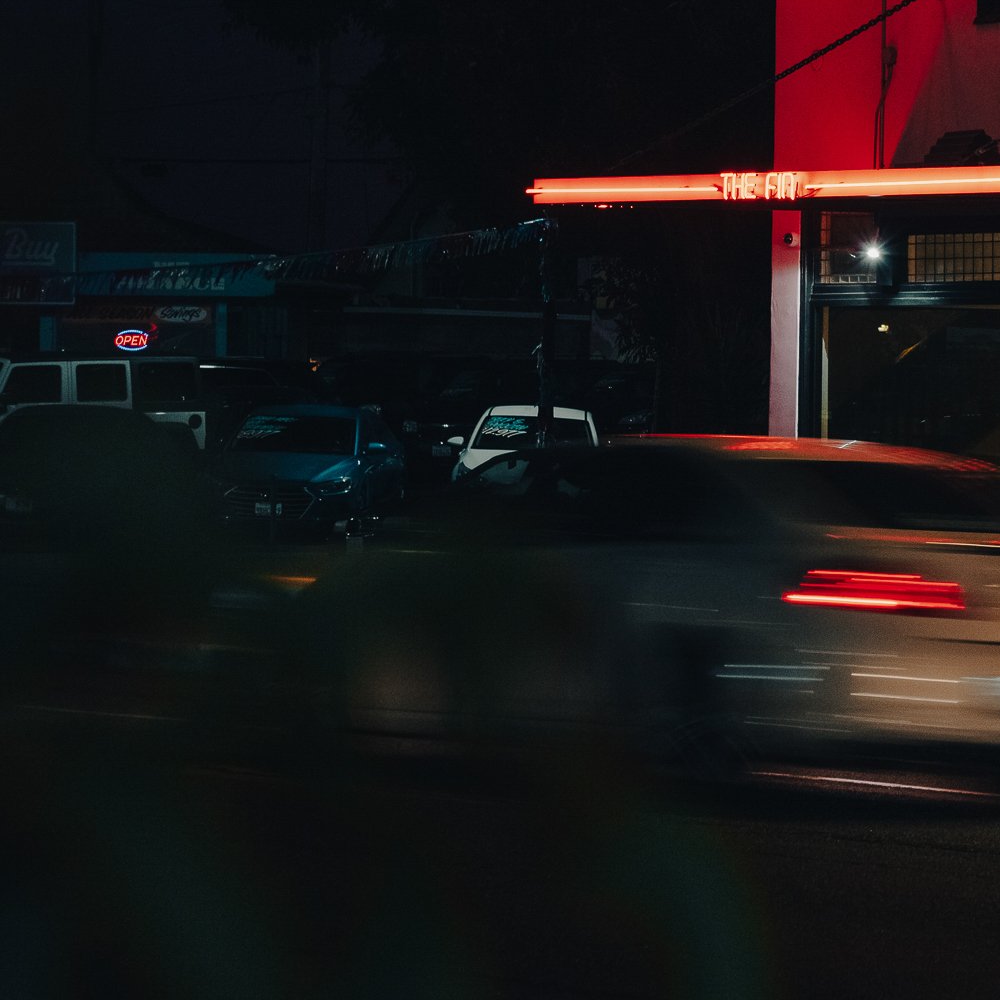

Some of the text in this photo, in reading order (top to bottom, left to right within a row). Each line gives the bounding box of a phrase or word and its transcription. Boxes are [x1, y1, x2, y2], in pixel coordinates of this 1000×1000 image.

[720, 172, 796, 200] THE FIN
[2, 227, 60, 266] Buy
[115, 335, 148, 347] OPEN
